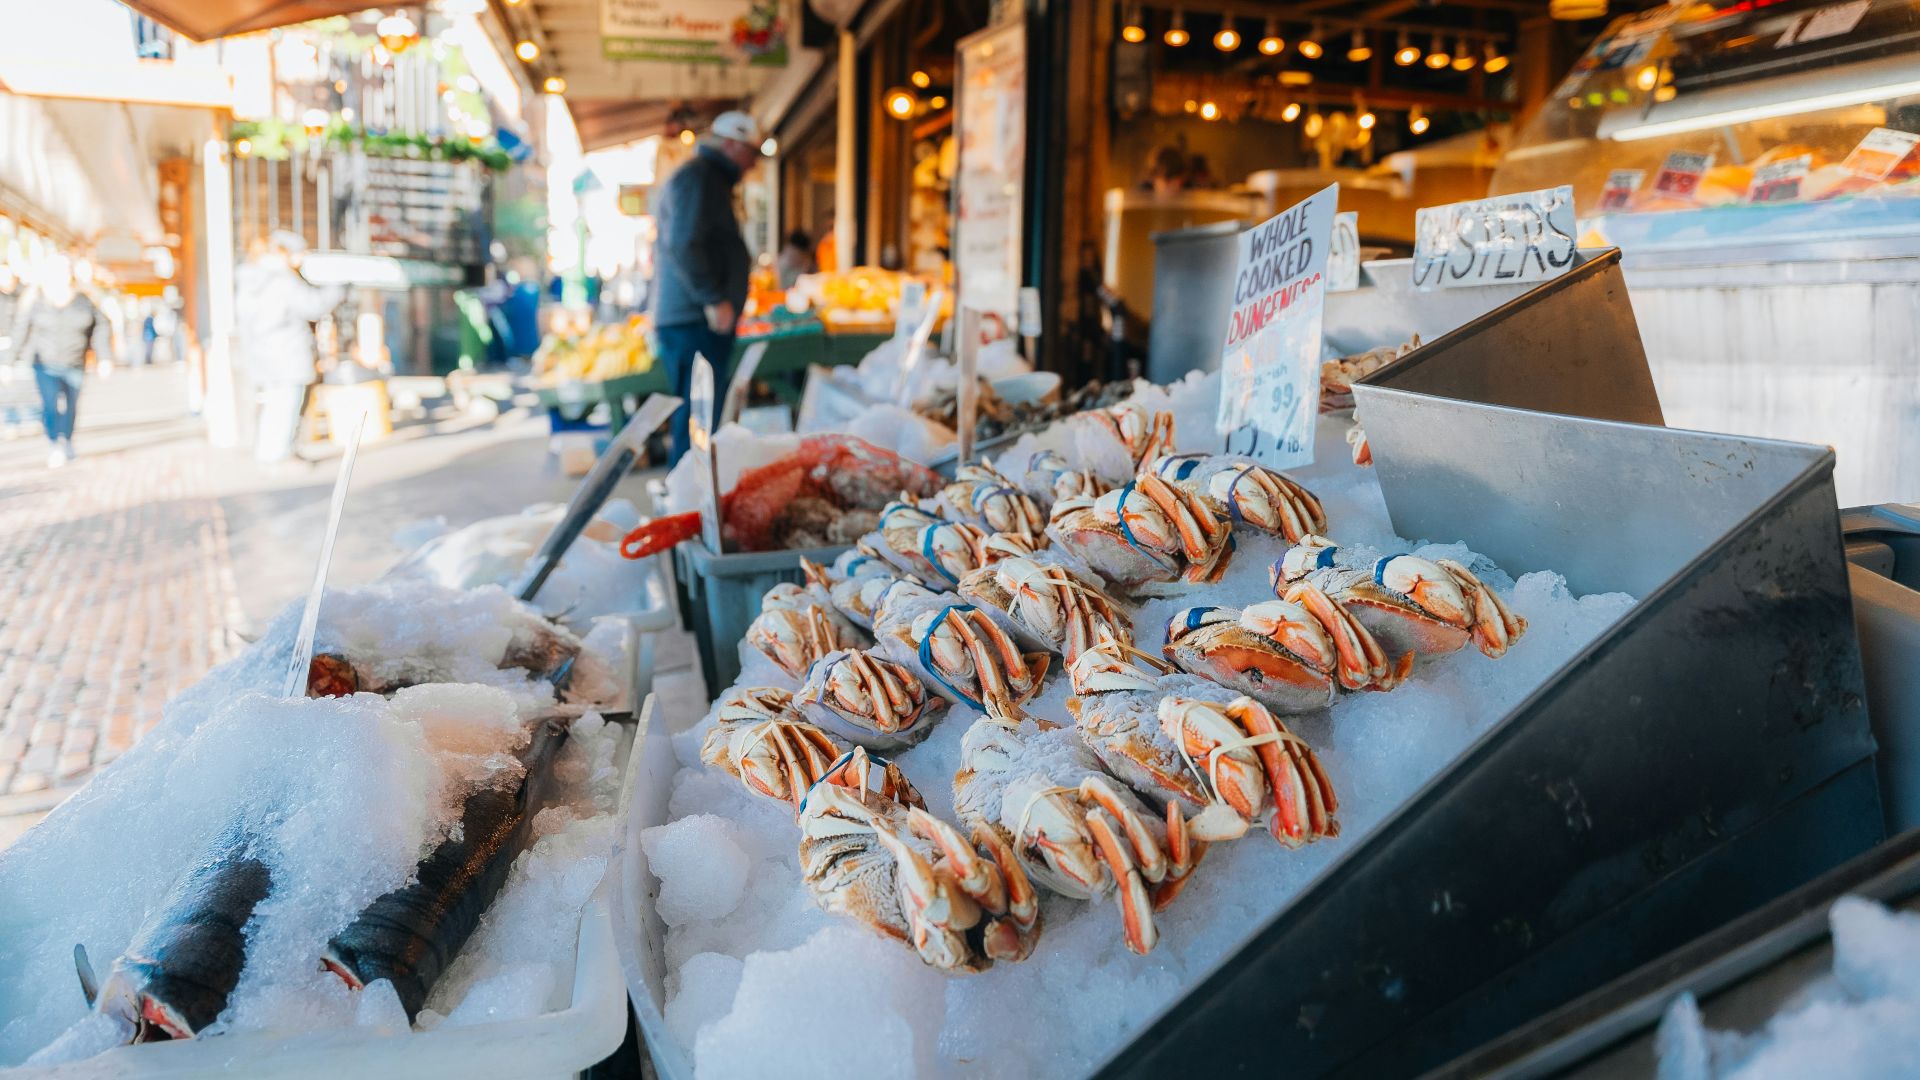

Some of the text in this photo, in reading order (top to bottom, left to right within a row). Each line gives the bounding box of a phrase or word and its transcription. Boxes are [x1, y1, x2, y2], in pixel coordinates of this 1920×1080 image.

[1249, 200, 1312, 263] WHOLE
[1412, 197, 1576, 287] OYSTERS
[1235, 237, 1313, 305] COOKED
